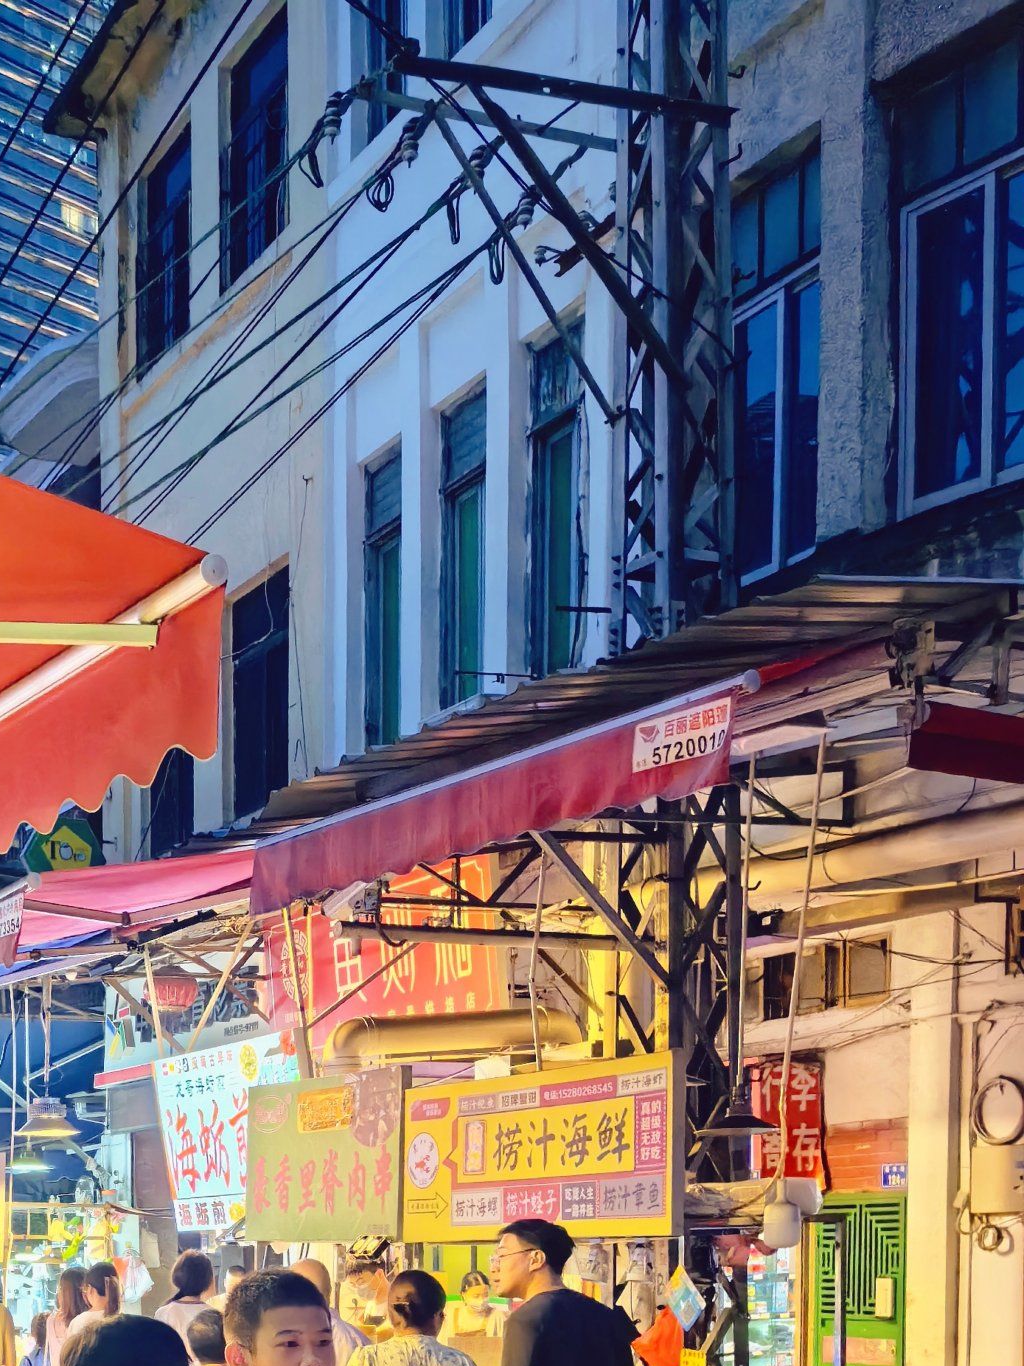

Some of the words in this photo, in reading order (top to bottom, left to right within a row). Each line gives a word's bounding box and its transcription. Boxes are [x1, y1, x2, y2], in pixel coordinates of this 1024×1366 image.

[641, 1100, 661, 1114] 真的
[493, 1107, 631, 1171] 捞汁海鲜
[641, 1131, 661, 1145] 无敌
[641, 1147, 661, 1160] 好吃
[603, 1182, 659, 1211] 捞汁章鱼
